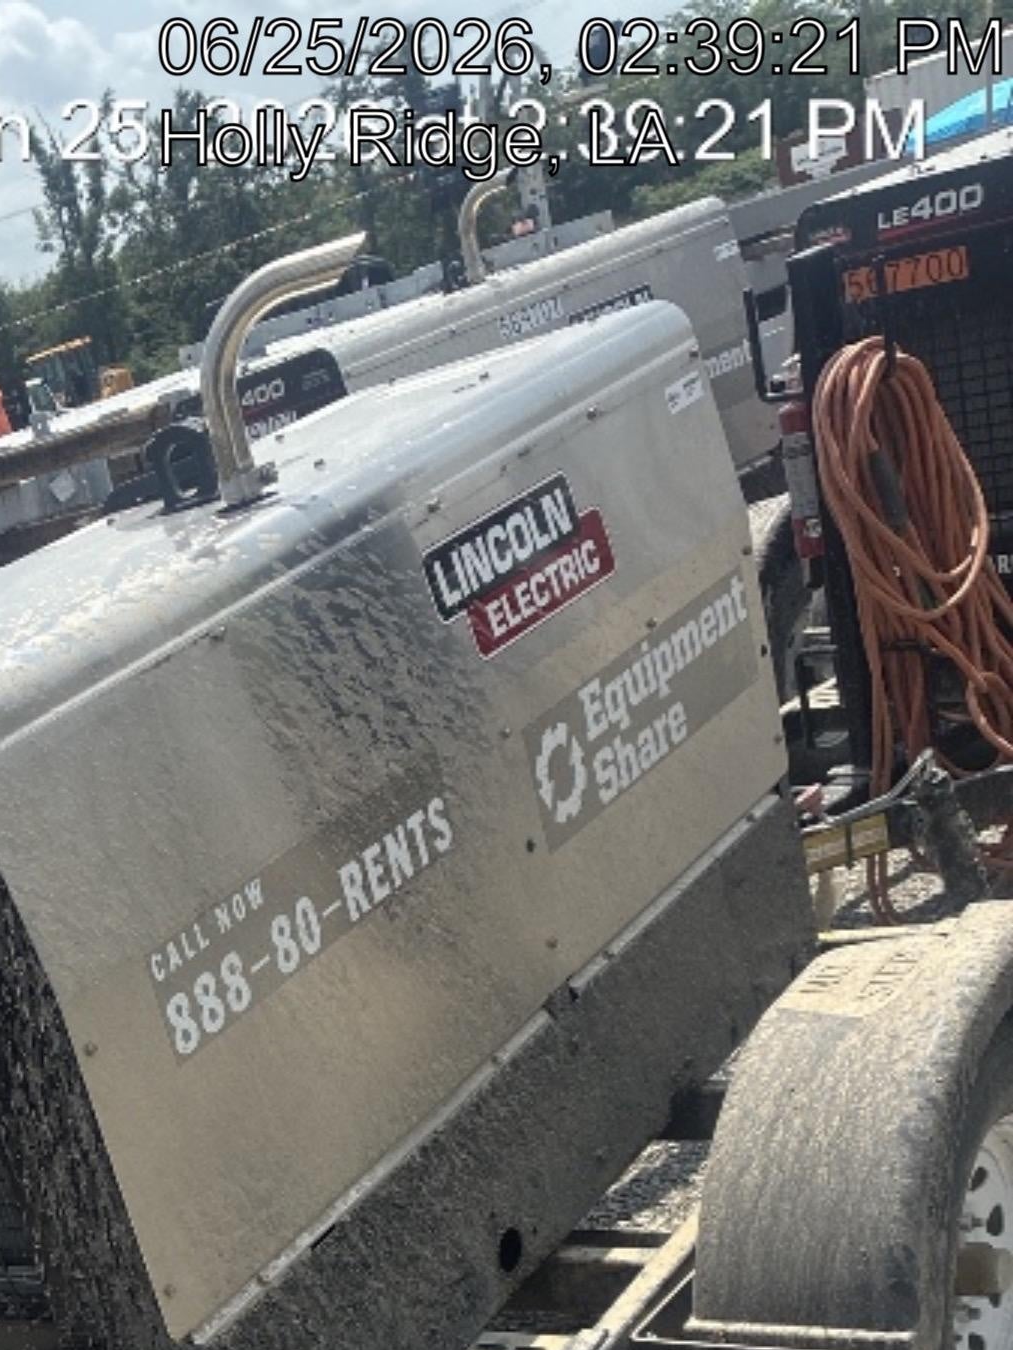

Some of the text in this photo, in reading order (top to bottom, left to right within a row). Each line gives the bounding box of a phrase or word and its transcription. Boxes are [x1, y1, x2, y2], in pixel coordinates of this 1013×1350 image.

[876, 183, 985, 230] LE400
[241, 379, 286, 407] 400
[434, 487, 574, 608] LINCOLN
[487, 540, 601, 638] ELECTRIC
[578, 575, 748, 741] Equipment
[592, 701, 688, 805] Share
[150, 878, 264, 982] CALL NOW
[166, 797, 454, 1055] 888-80-RENTS
